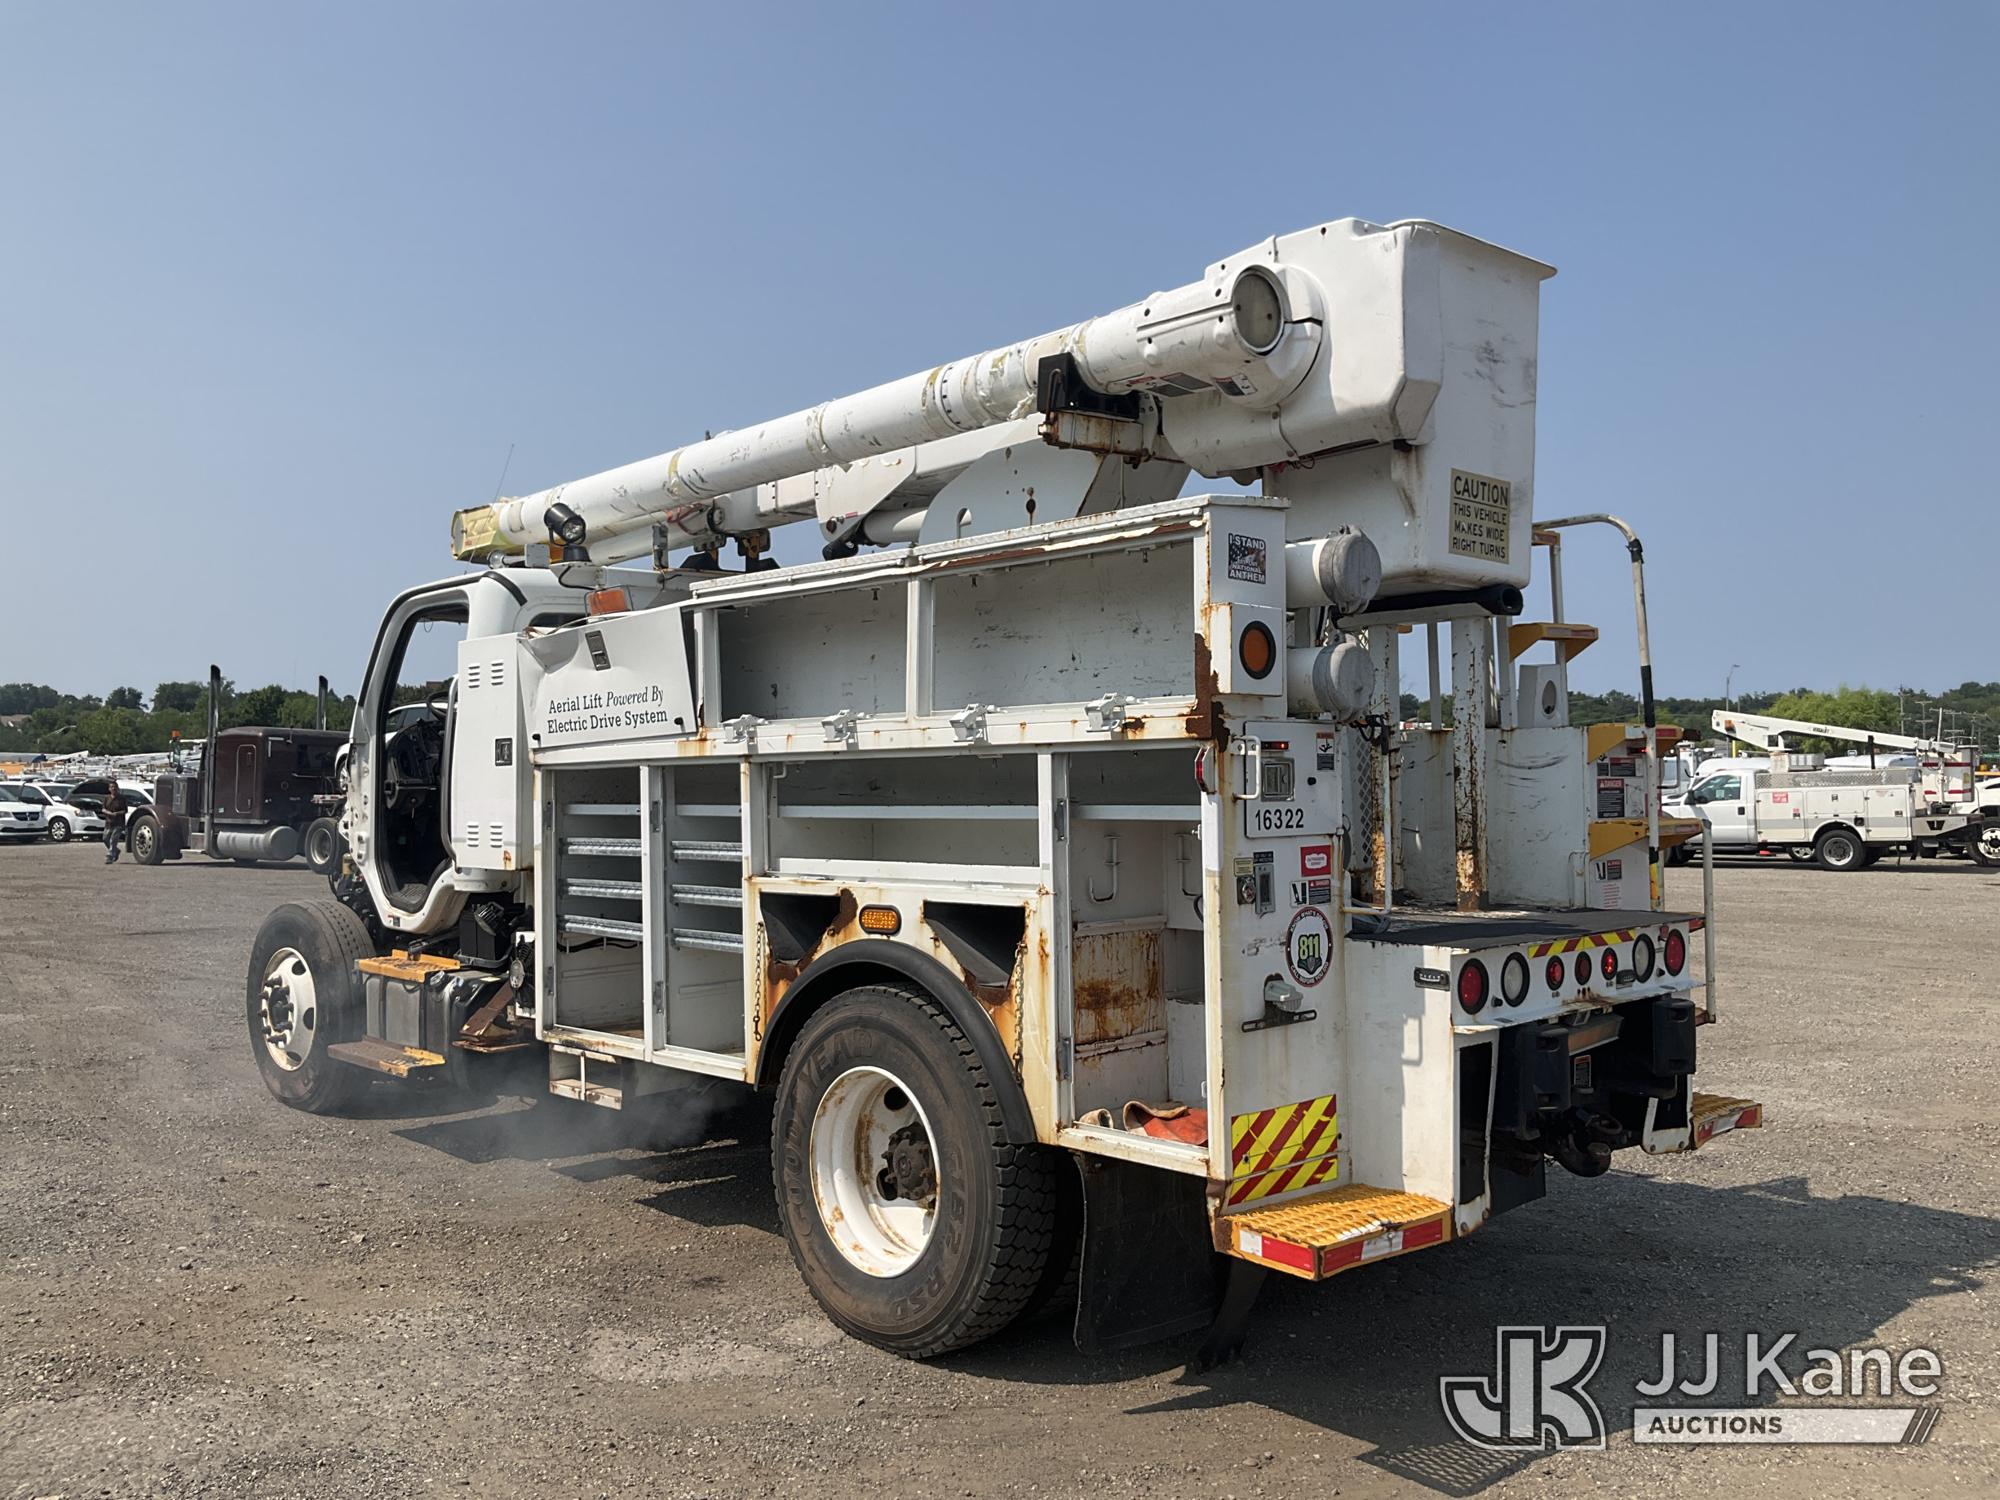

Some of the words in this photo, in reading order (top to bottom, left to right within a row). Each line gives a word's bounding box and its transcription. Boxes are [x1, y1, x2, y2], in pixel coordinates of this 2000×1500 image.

[1454, 475, 1509, 506] CAUTION
[1453, 502, 1472, 518] THIS
[1474, 507, 1507, 525] VEHICLE
[1454, 520, 1483, 537] MAKES
[1485, 526, 1505, 542] WIDE
[1235, 536, 1265, 550] STAND
[1452, 537, 1477, 553] RIGHT
[1479, 542, 1506, 559] TURNS
[1230, 569, 1265, 582] ANTHEM
[549, 696, 580, 714] Aerial
[583, 693, 604, 711] Lift
[606, 687, 648, 707] Powered
[651, 685, 664, 707] By
[547, 714, 588, 734] Electric
[590, 713, 622, 730] Drive
[624, 709, 668, 729] System
[1255, 808, 1305, 831] 16322
[1299, 935, 1319, 960] 811
